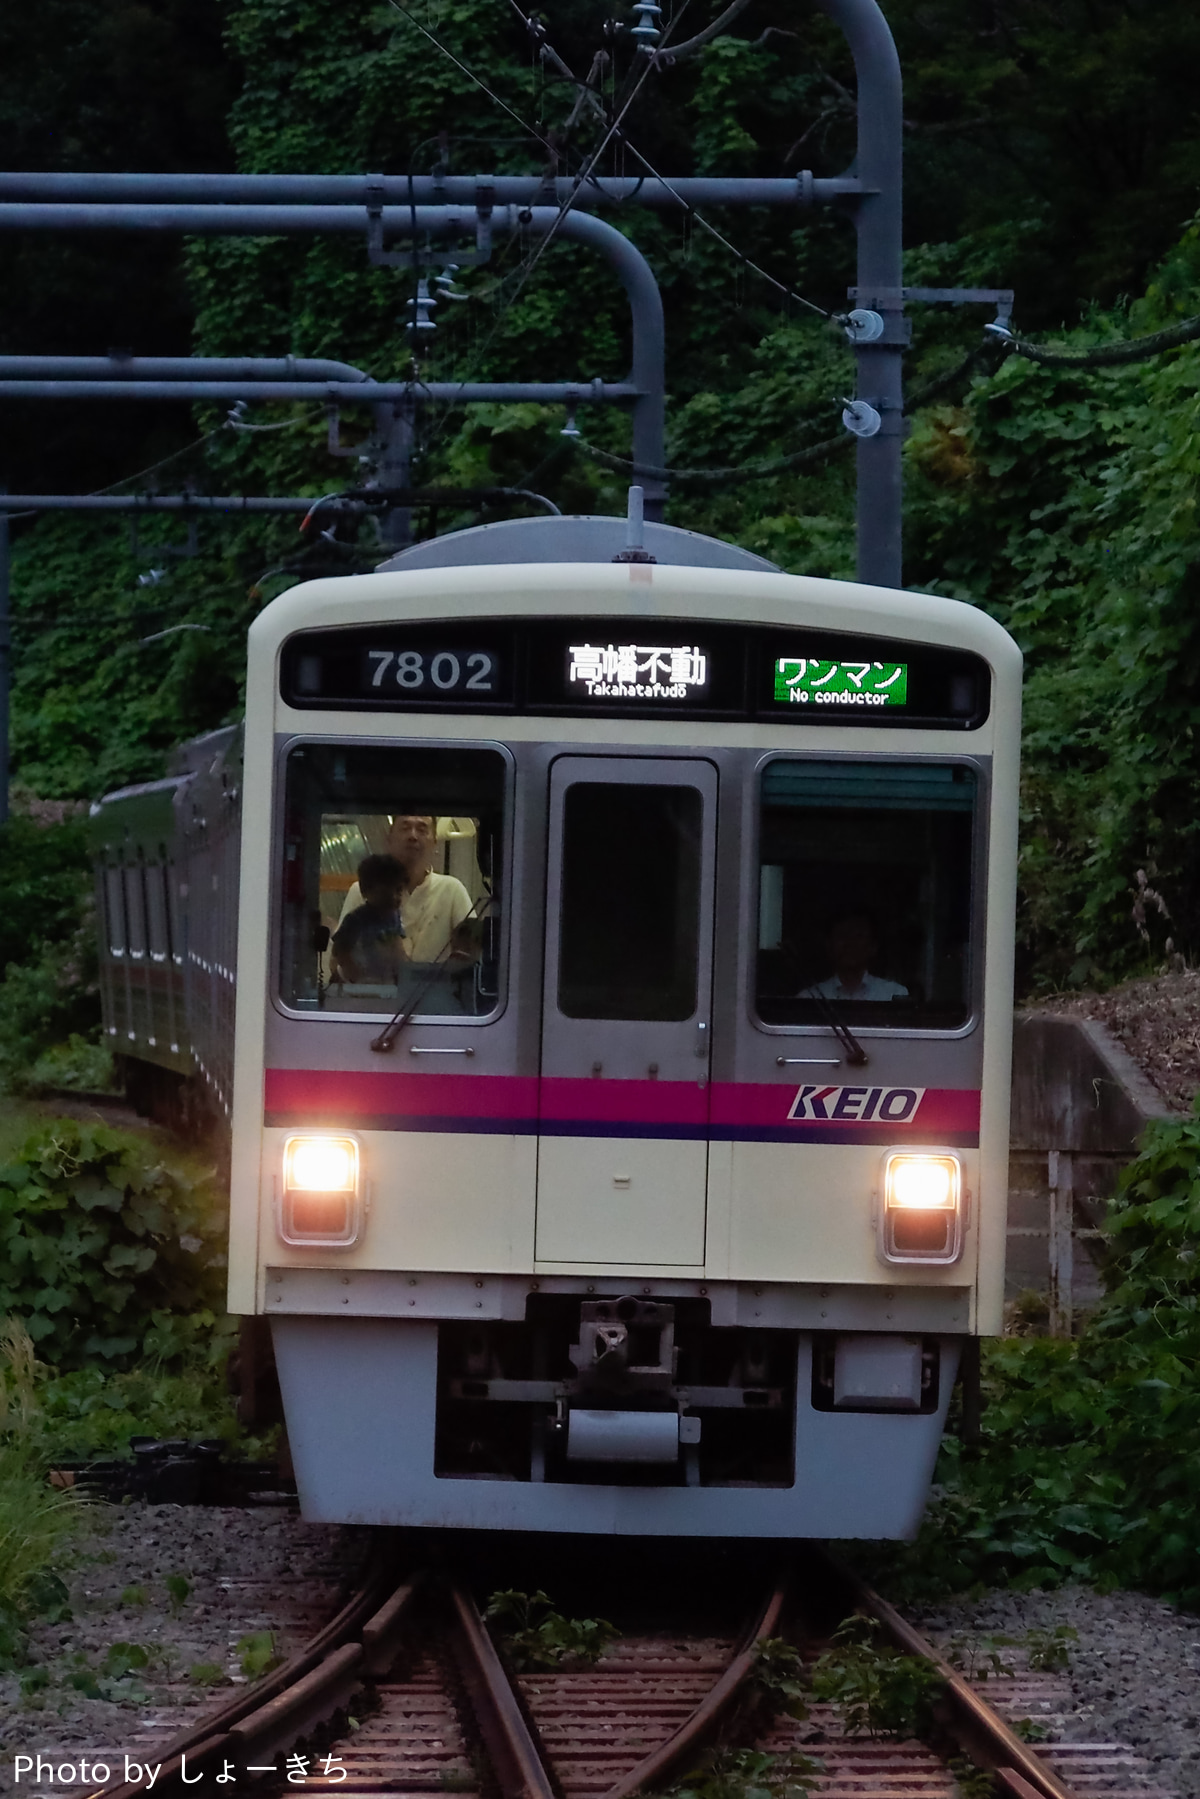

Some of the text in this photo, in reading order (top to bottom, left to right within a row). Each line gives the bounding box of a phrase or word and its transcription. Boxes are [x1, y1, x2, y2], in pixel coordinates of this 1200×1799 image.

[368, 651, 492, 689] 7802
[569, 643, 706, 685] 高幡不動
[779, 657, 902, 689] ワンマン
[789, 687, 890, 705] No conductor
[792, 1086, 918, 1121] KEIO
